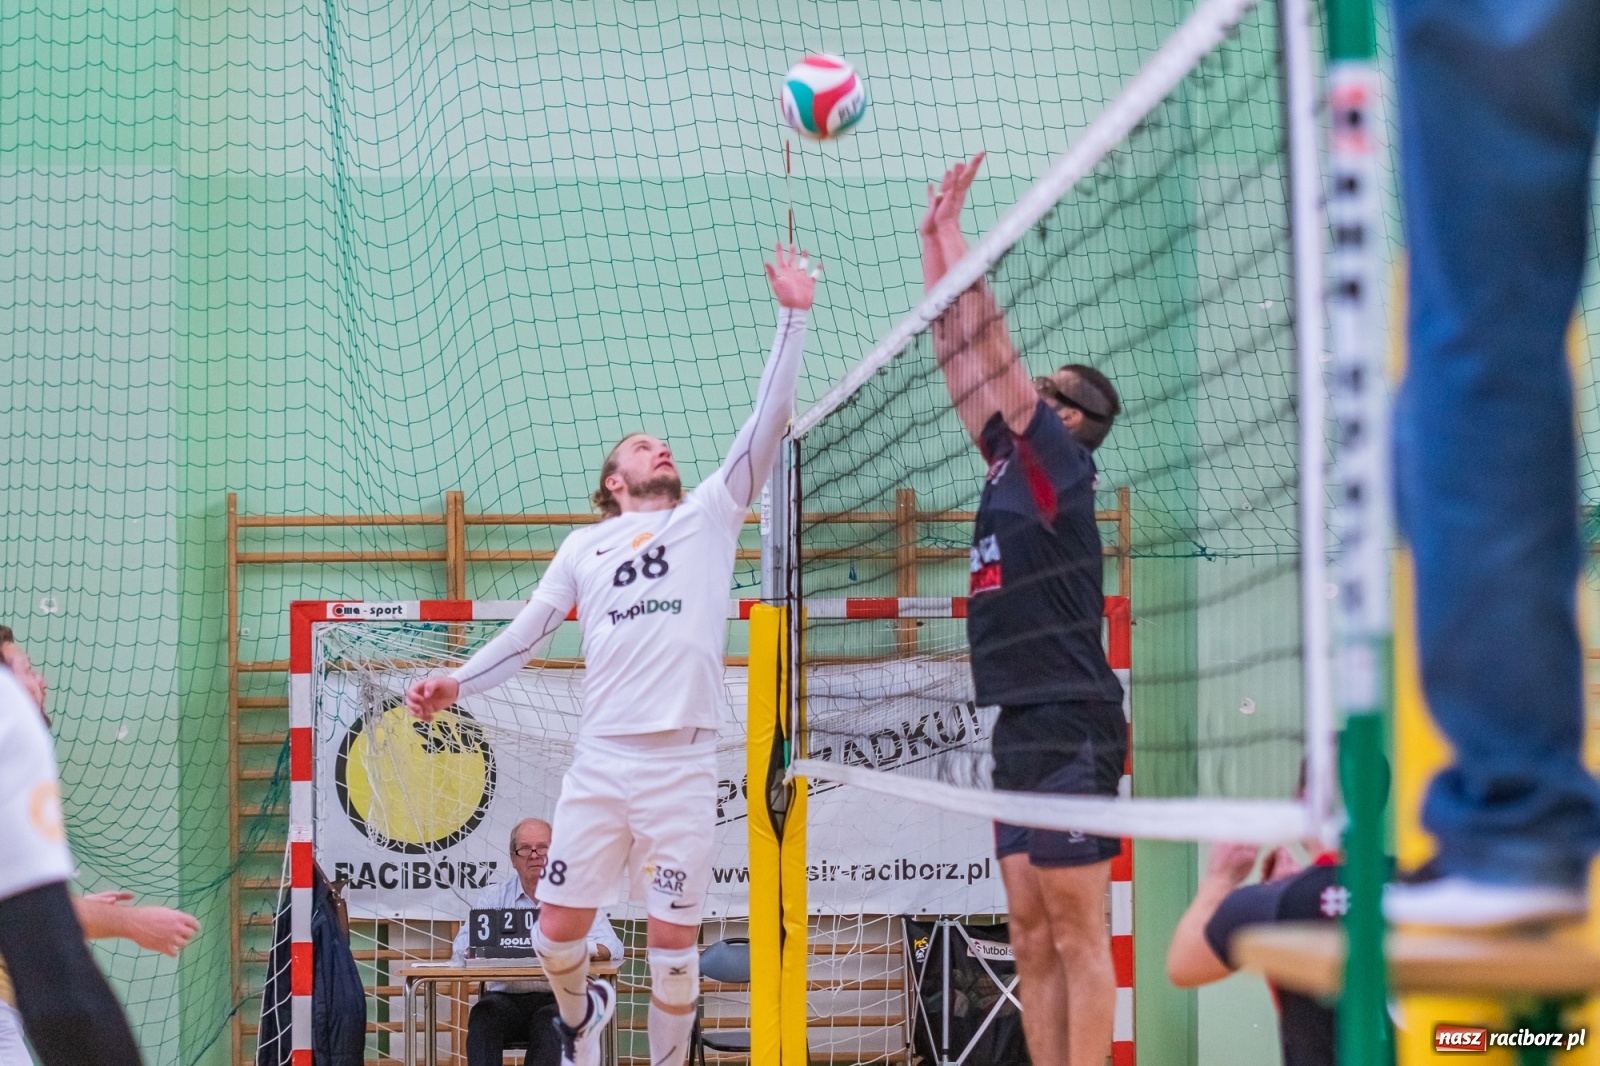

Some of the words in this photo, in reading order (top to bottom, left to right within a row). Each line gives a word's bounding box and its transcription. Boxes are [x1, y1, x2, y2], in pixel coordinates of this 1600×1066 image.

[613, 545, 669, 587] 68
[370, 605, 402, 617] sport
[477, 914, 490, 940] 3
[504, 912, 513, 929] 2
[500, 938, 531, 946] JOOLA
